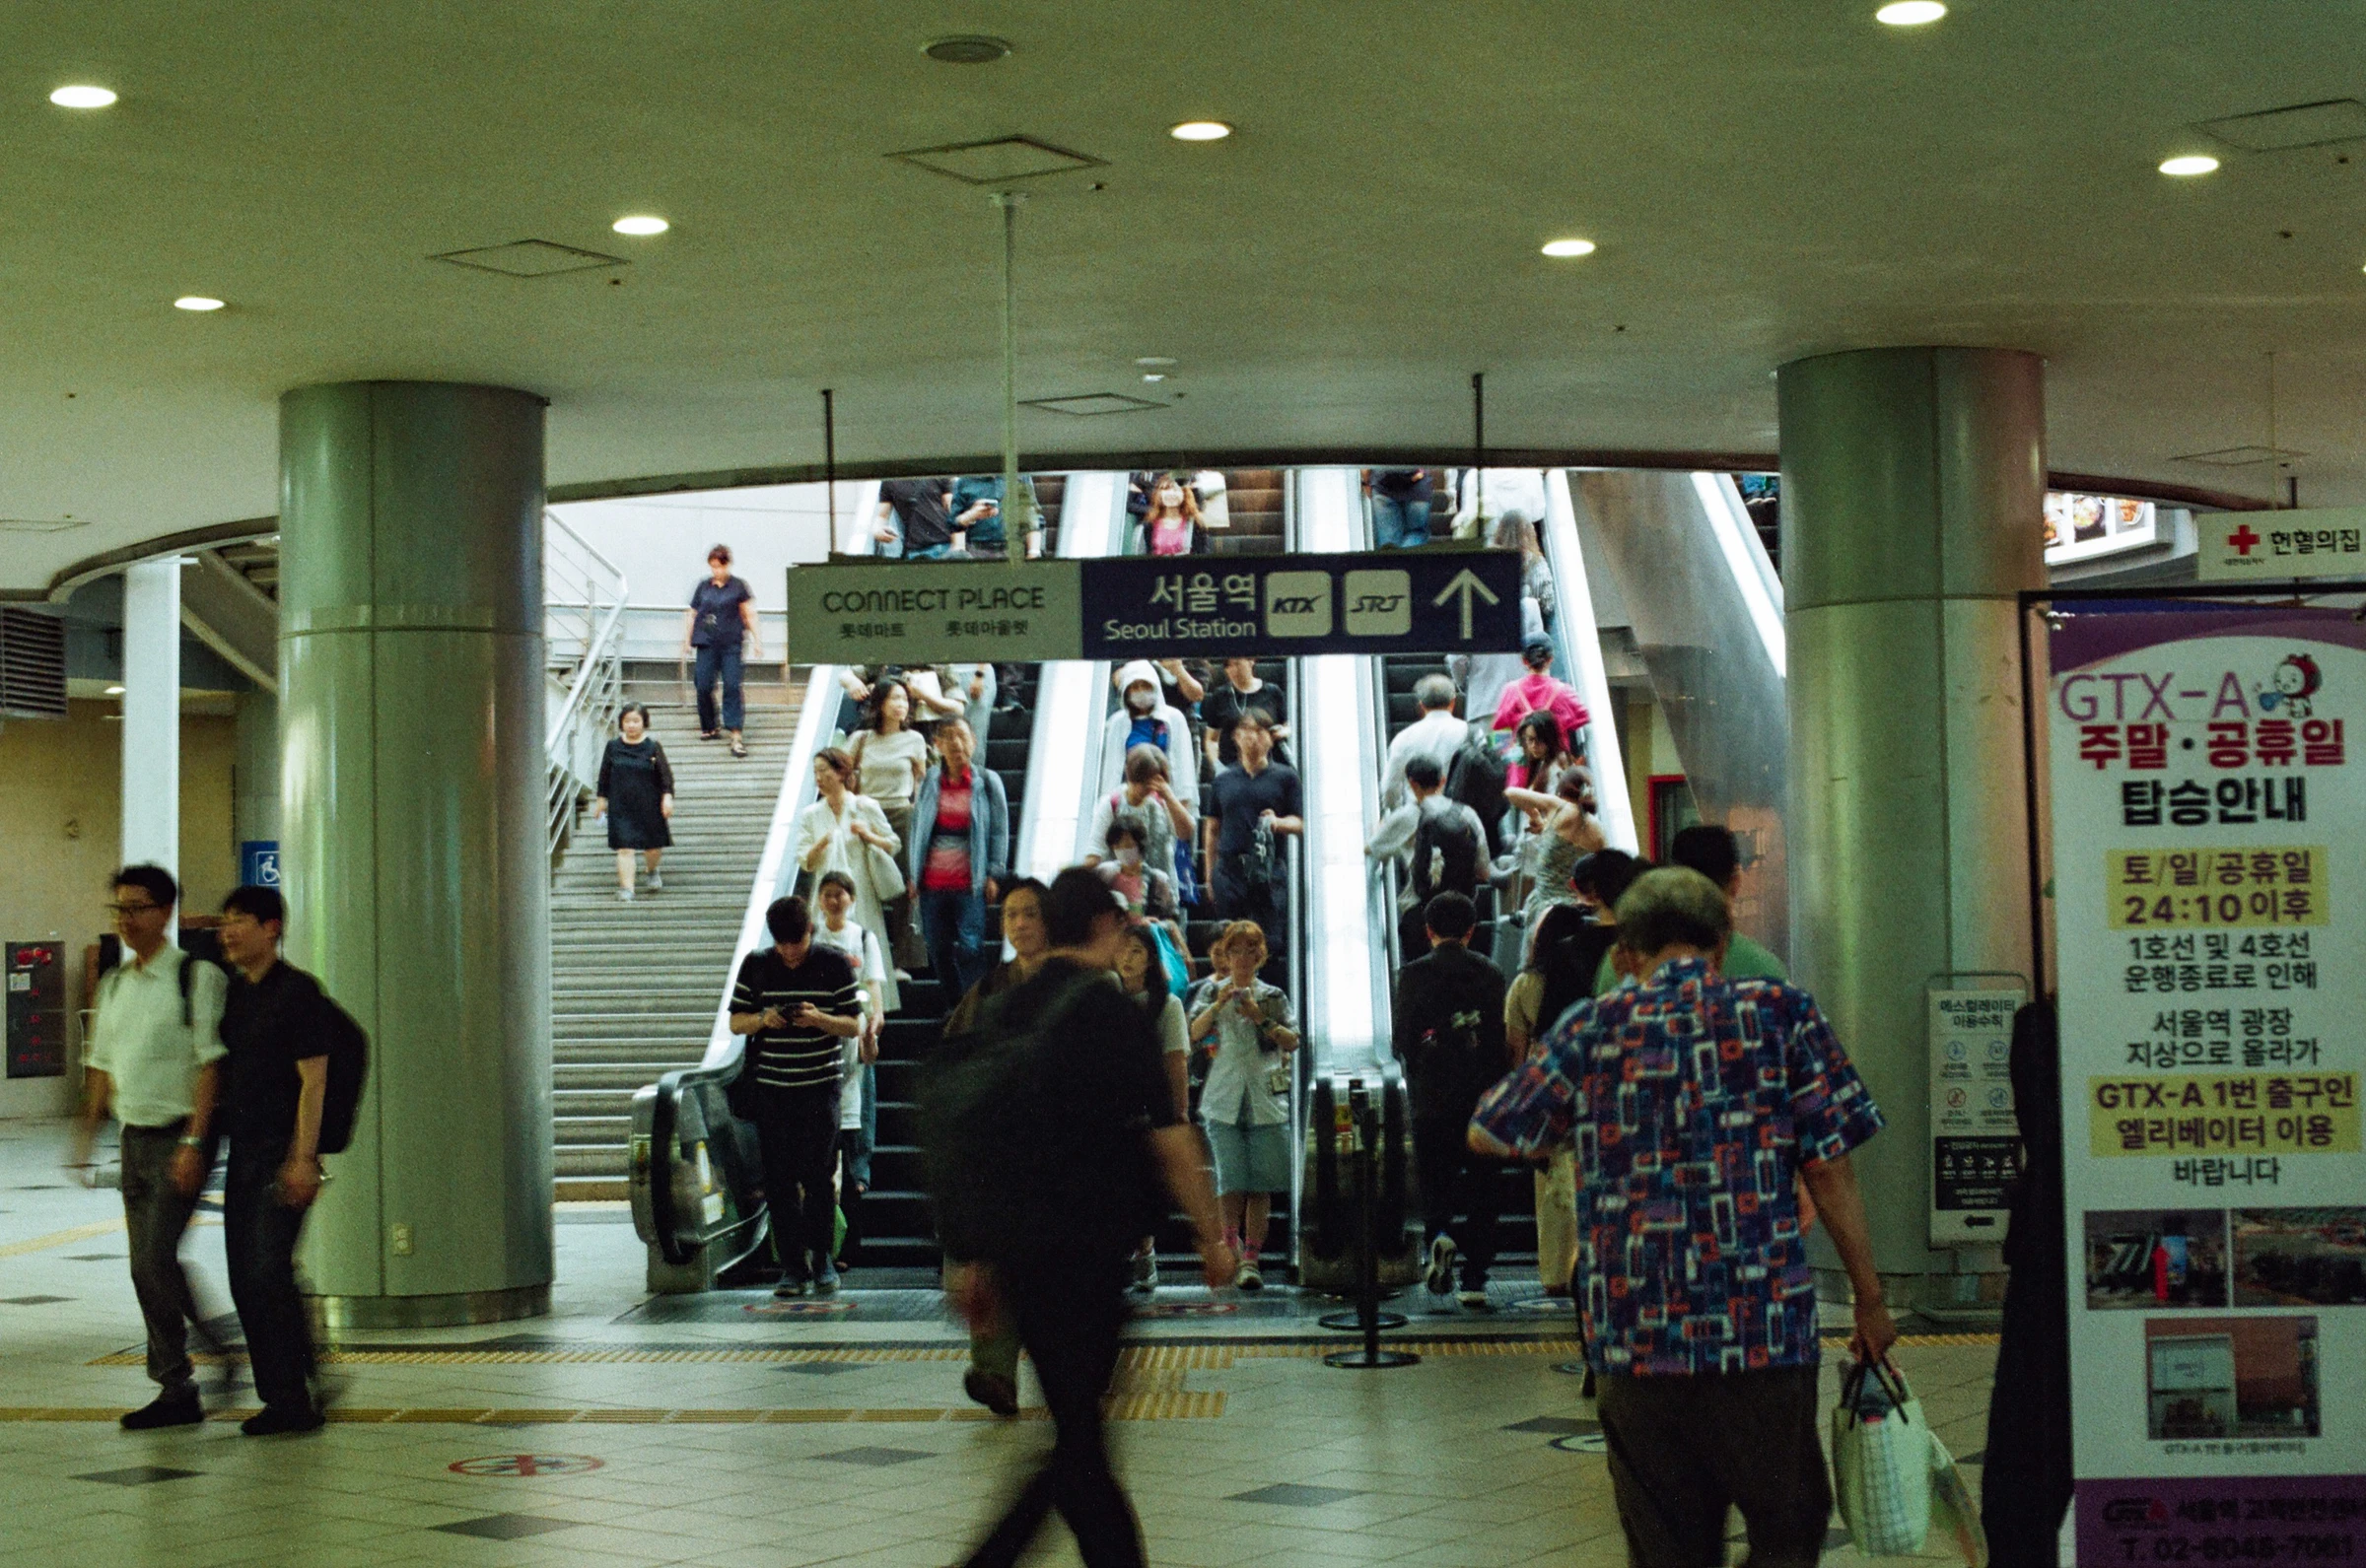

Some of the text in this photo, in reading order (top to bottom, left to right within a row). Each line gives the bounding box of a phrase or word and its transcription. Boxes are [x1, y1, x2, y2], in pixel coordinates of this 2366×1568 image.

[2270, 528, 2360, 555] 헌혈의집
[822, 587, 1045, 613] CONNECT PLACE
[1148, 572, 1256, 613] 서울역
[1272, 596, 1325, 614] KTX
[1350, 594, 1405, 613] SRT
[840, 622, 905, 639] 롯데마트
[1104, 617, 1256, 641] Seoul Station
[2059, 671, 2252, 722] GTX-A
[2128, 931, 2312, 961] 1호선 및 4호선
[2125, 961, 2318, 993] 운행종료로 인해
[1939, 998, 2017, 1013] 에스컬레이터
[2152, 1006, 2293, 1038] 서울역 광장
[2126, 1037, 2321, 1068] 지상으로 올라가
[2096, 1075, 2354, 1110] GTX-A 1번 출구인
[2275, 1114, 2334, 1147] 이용
[2174, 1157, 2281, 1187] 바랍니다
